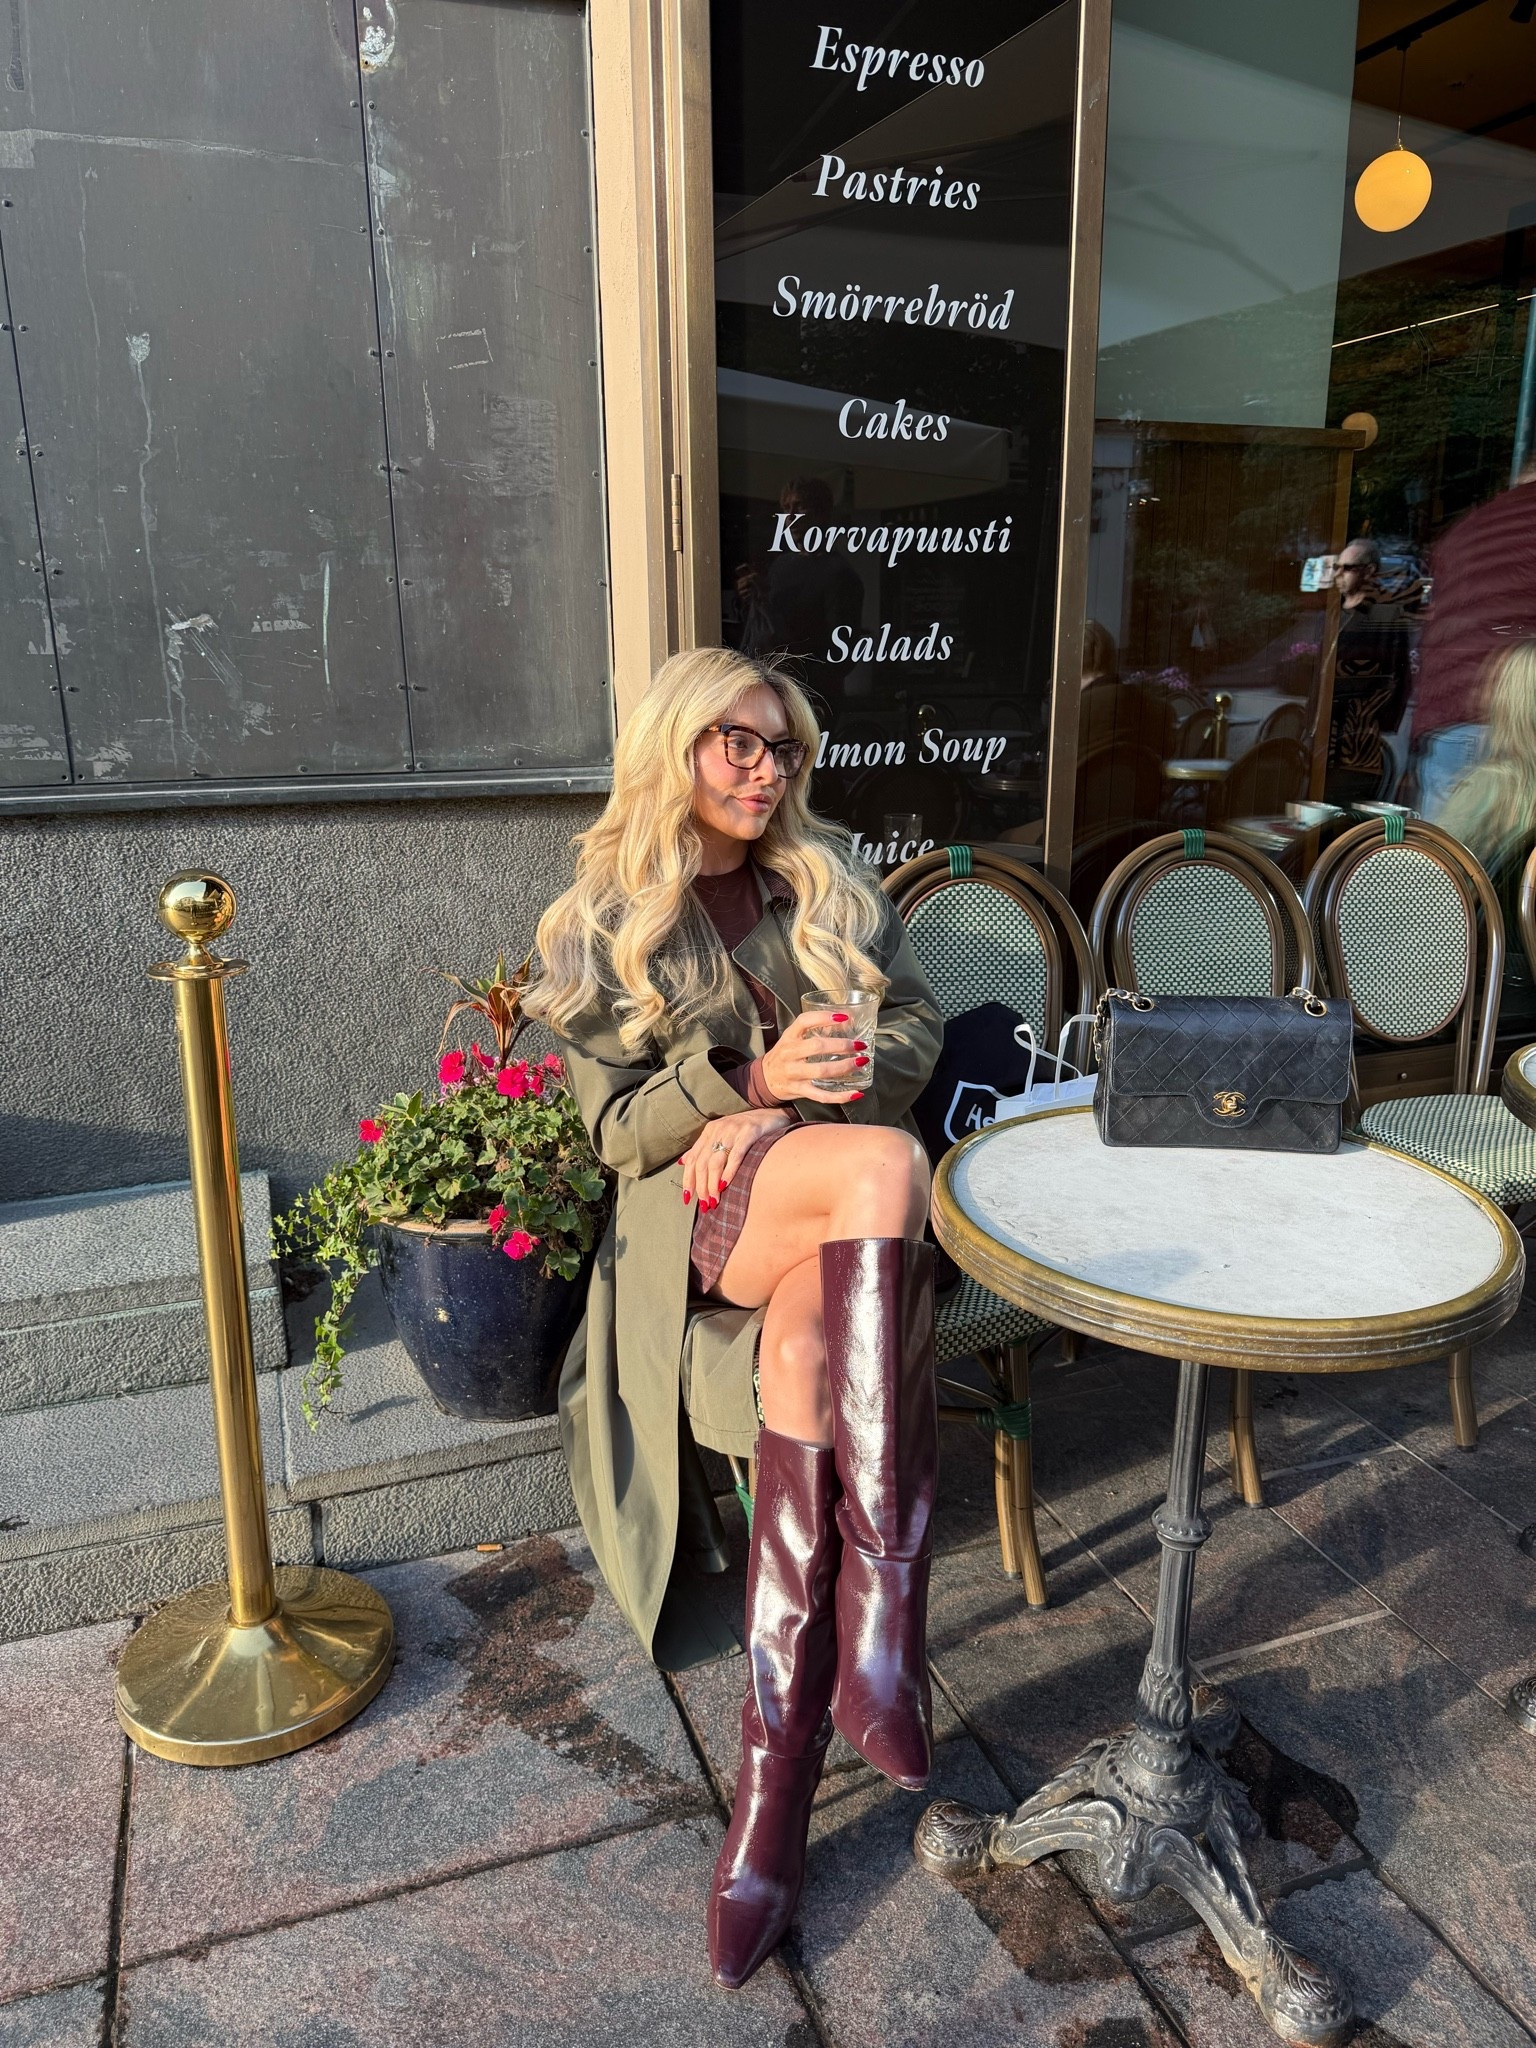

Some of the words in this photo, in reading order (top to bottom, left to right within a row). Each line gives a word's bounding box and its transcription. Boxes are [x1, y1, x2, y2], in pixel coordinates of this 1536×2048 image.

[809, 24, 986, 92] Espresso
[811, 154, 981, 211] Pastries
[772, 275, 1015, 331] Smörrebröd
[838, 398, 951, 442] Cakes
[767, 512, 1013, 568] Korvapuusti
[826, 622, 954, 664] Salads
[814, 730, 906, 769] lmon
[918, 727, 1007, 775] Soup
